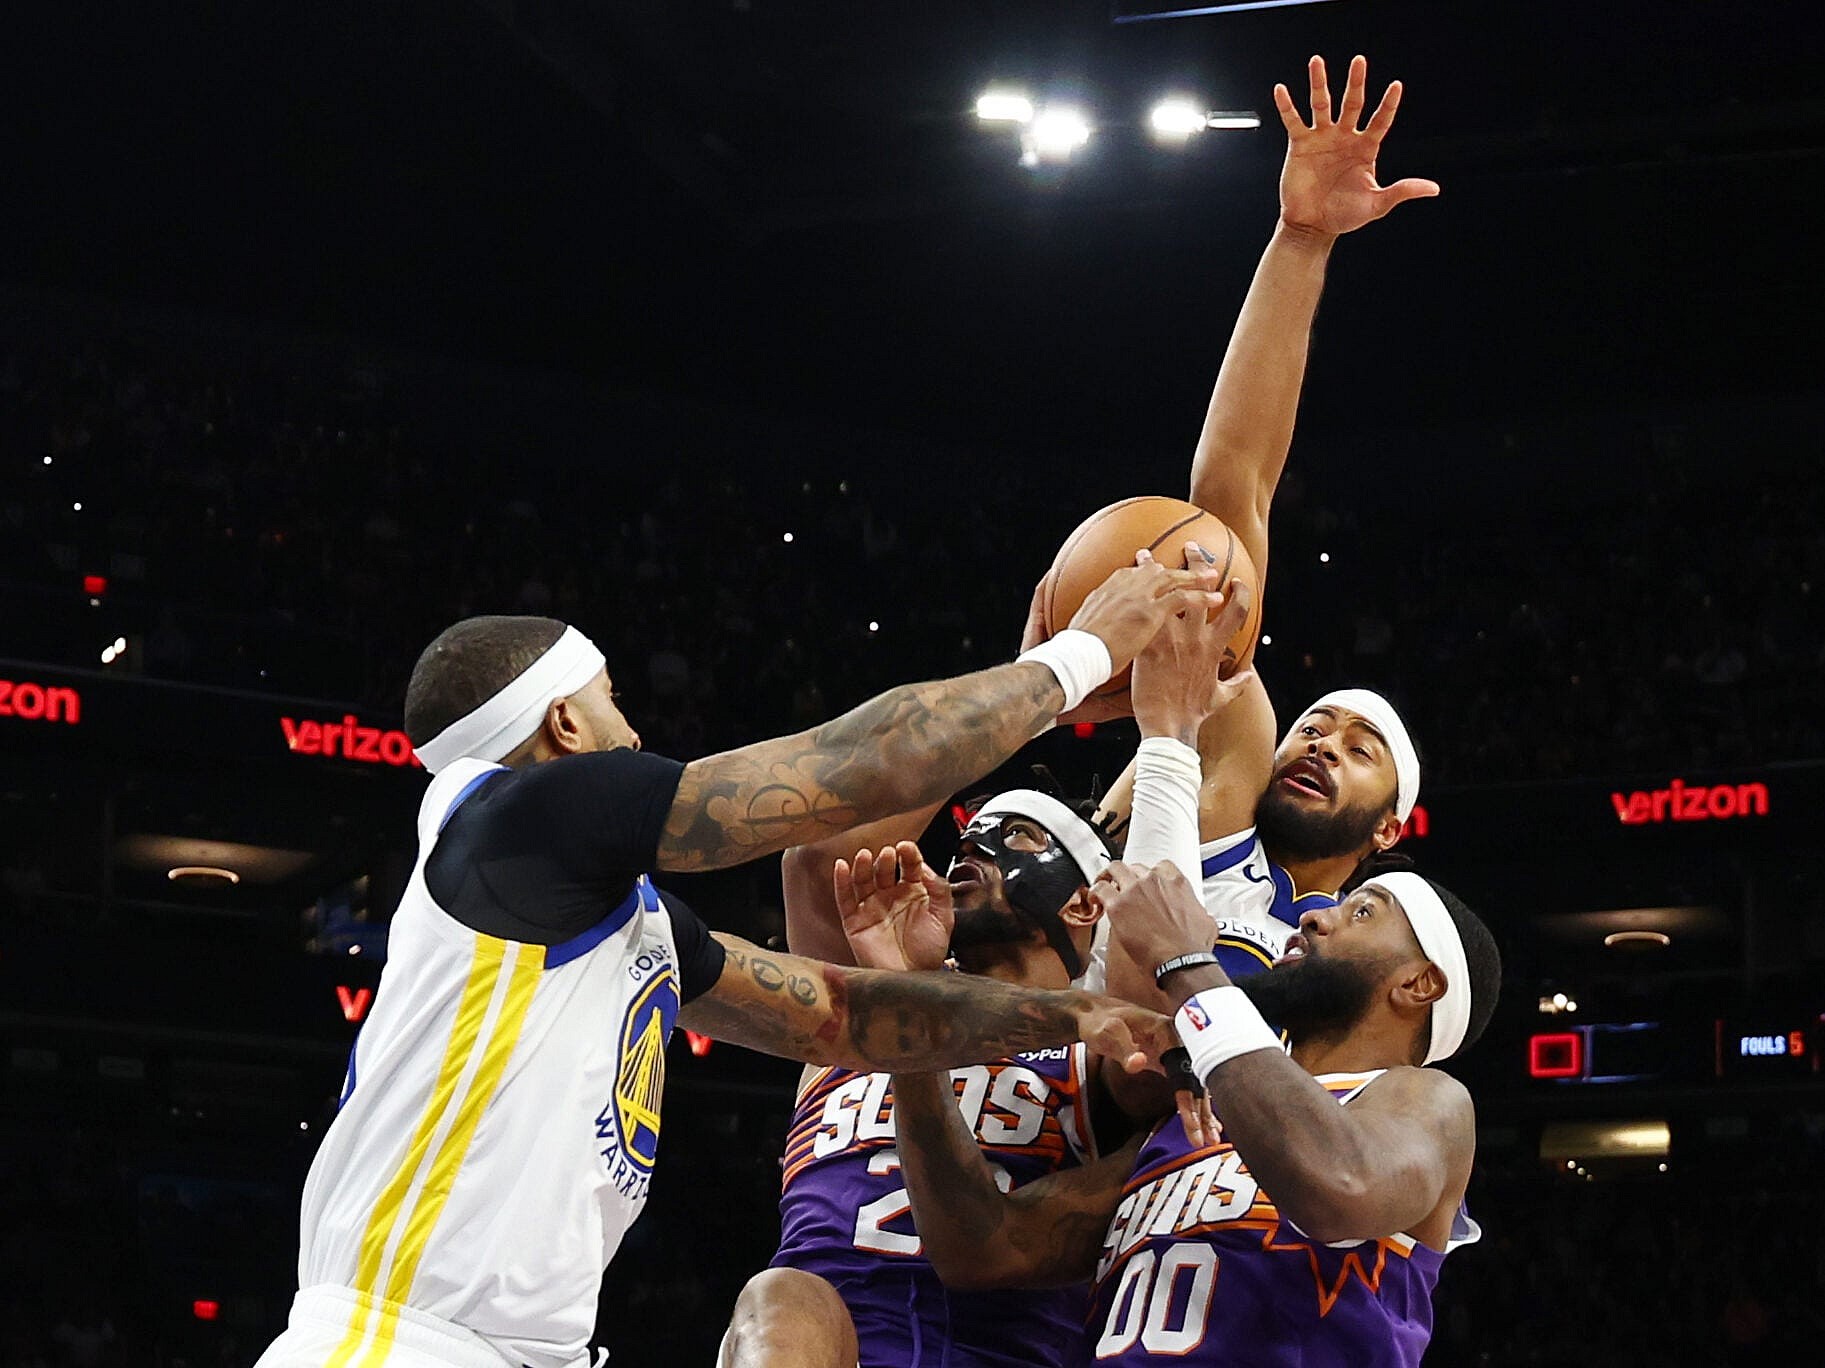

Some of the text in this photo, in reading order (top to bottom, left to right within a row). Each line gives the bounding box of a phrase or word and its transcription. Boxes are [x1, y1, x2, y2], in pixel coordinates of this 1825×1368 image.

[280, 714, 422, 768] verizo
[1611, 778, 1768, 825] verizon
[1218, 919, 1280, 955] OLDEN
[1018, 1046, 1068, 1062] yPal
[1741, 1031, 1804, 1057] FOULS 5
[594, 1102, 649, 1201] WARRI
[1096, 1150, 1259, 1284] SUNS
[1095, 1242, 1221, 1361] 00
